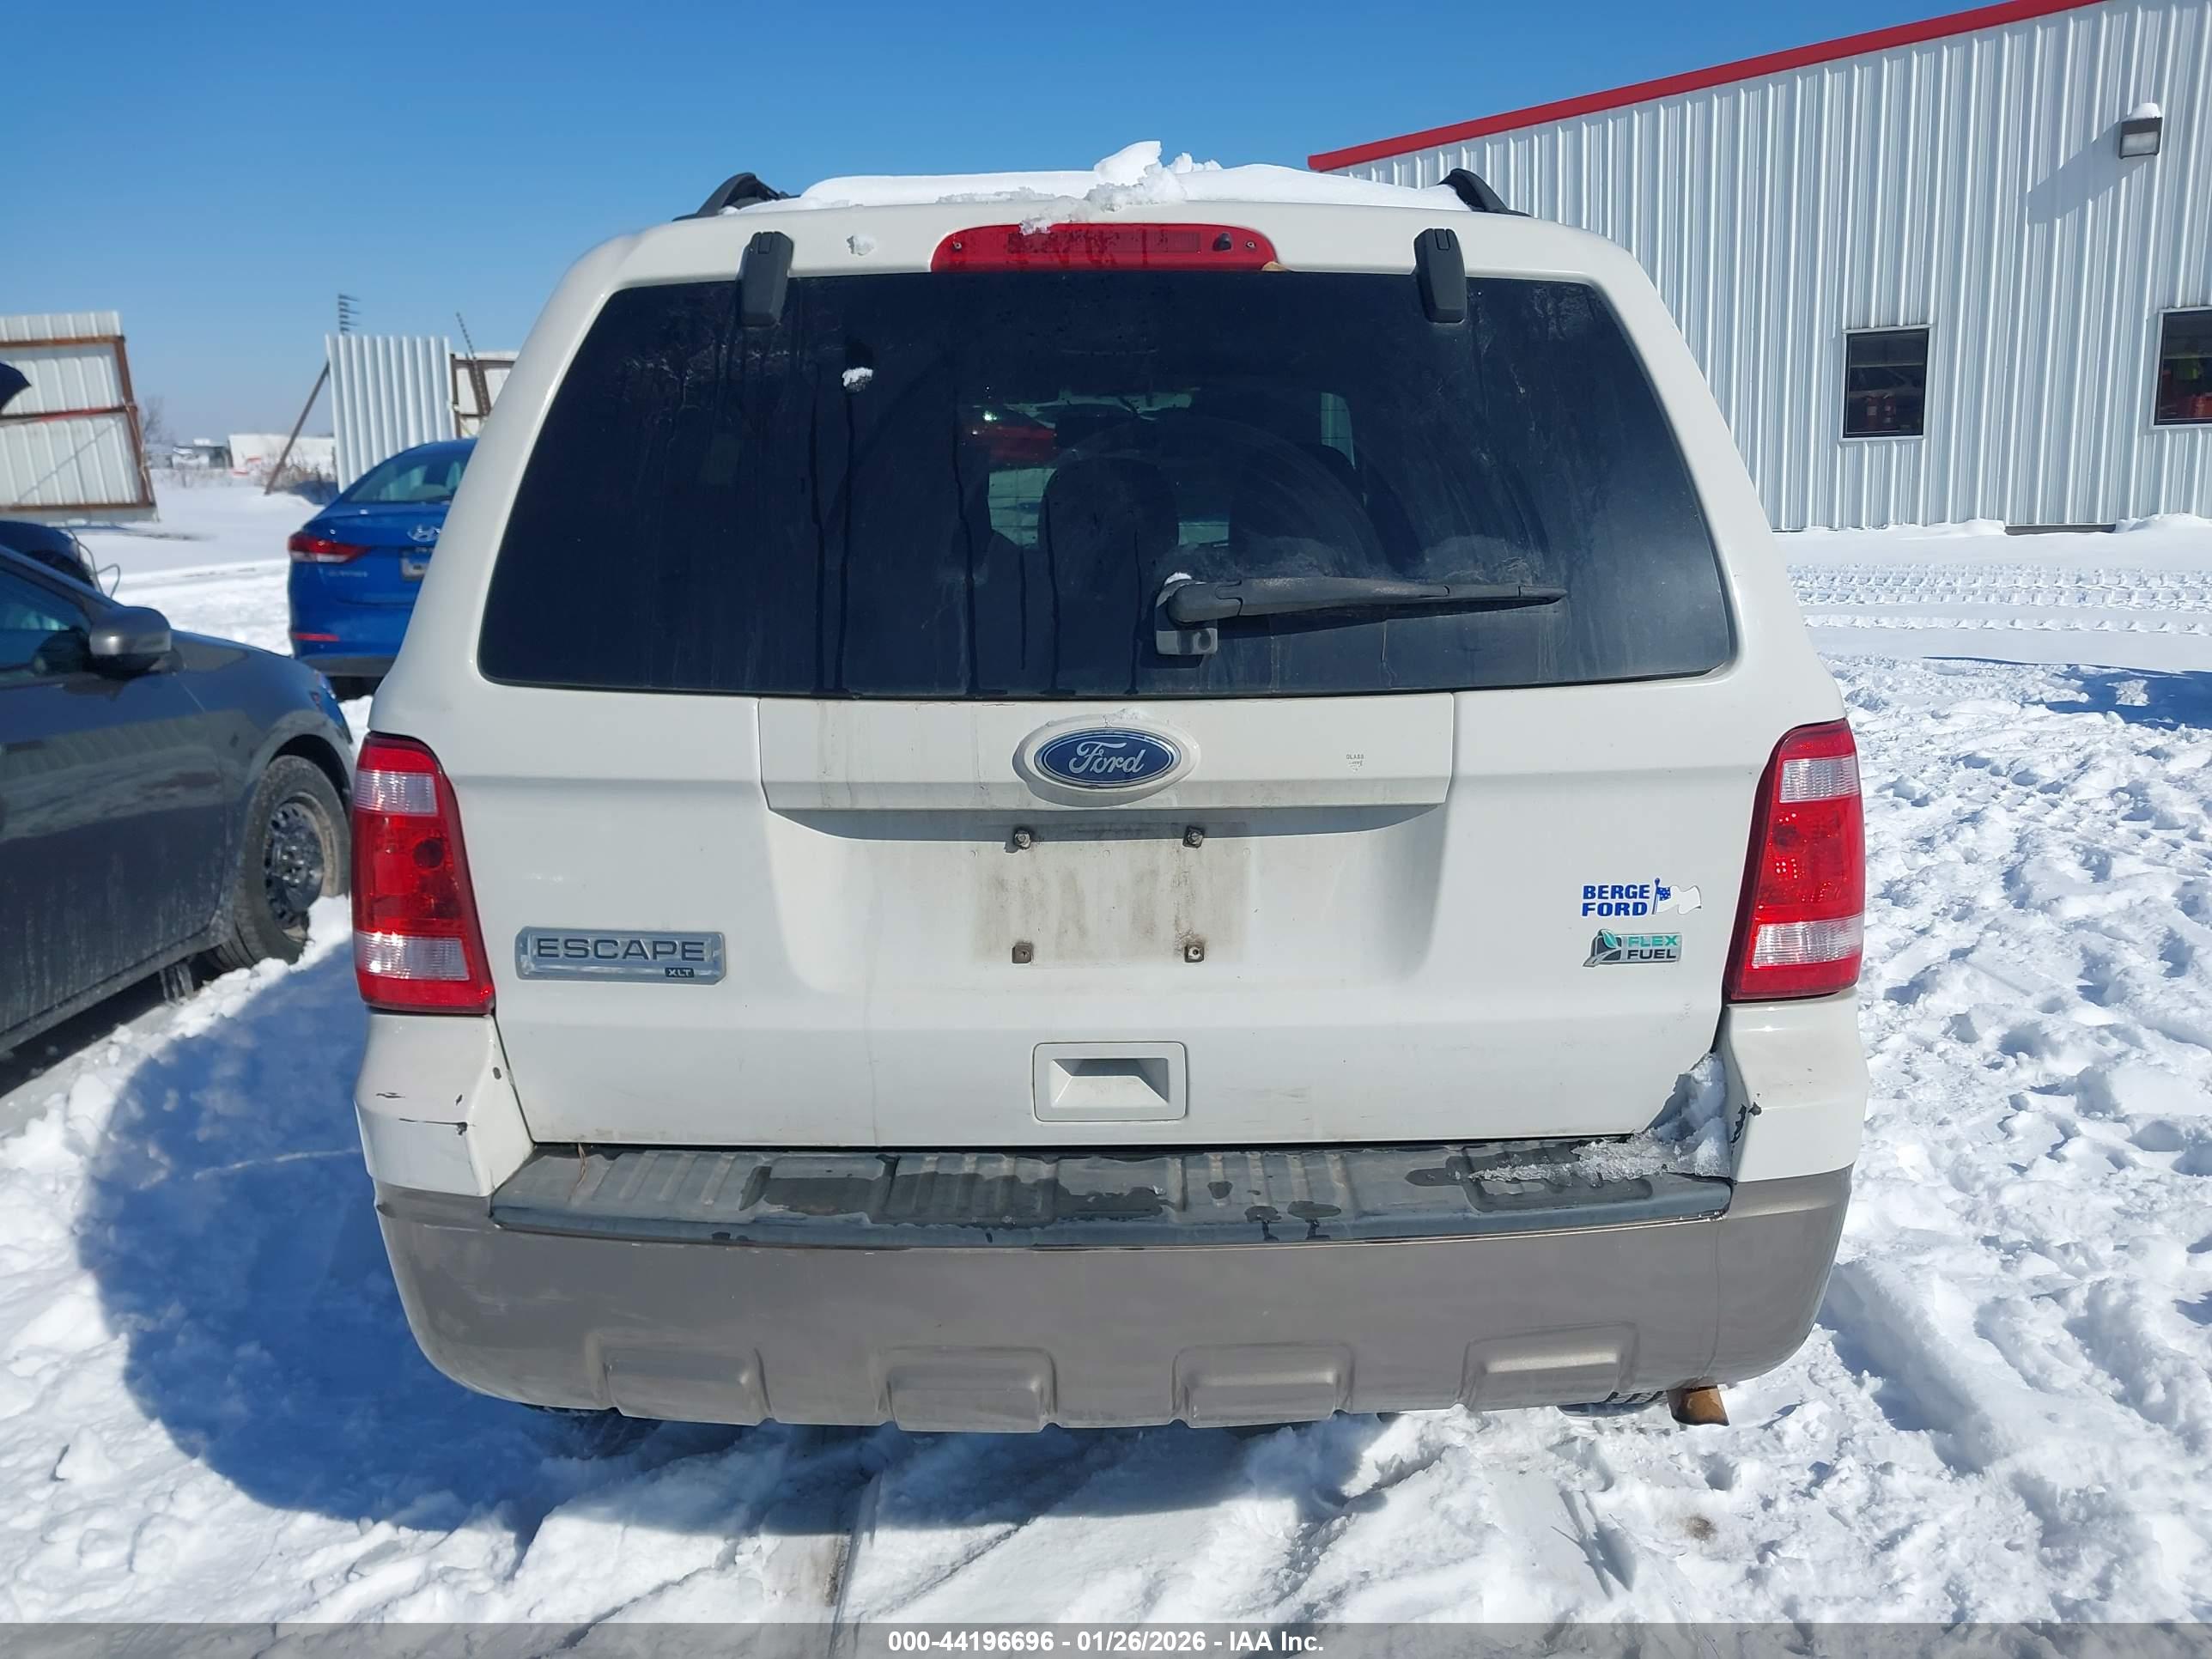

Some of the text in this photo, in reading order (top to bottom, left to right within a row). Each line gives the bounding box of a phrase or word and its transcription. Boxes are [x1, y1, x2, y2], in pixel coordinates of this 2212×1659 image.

[1068, 741, 1146, 774] Ford
[1583, 884, 1650, 900] BERGE
[1582, 902, 1648, 916] FORD
[1628, 936, 1679, 947] FLEX
[537, 938, 705, 961] ESCAPE
[1626, 950, 1677, 959] FUEL
